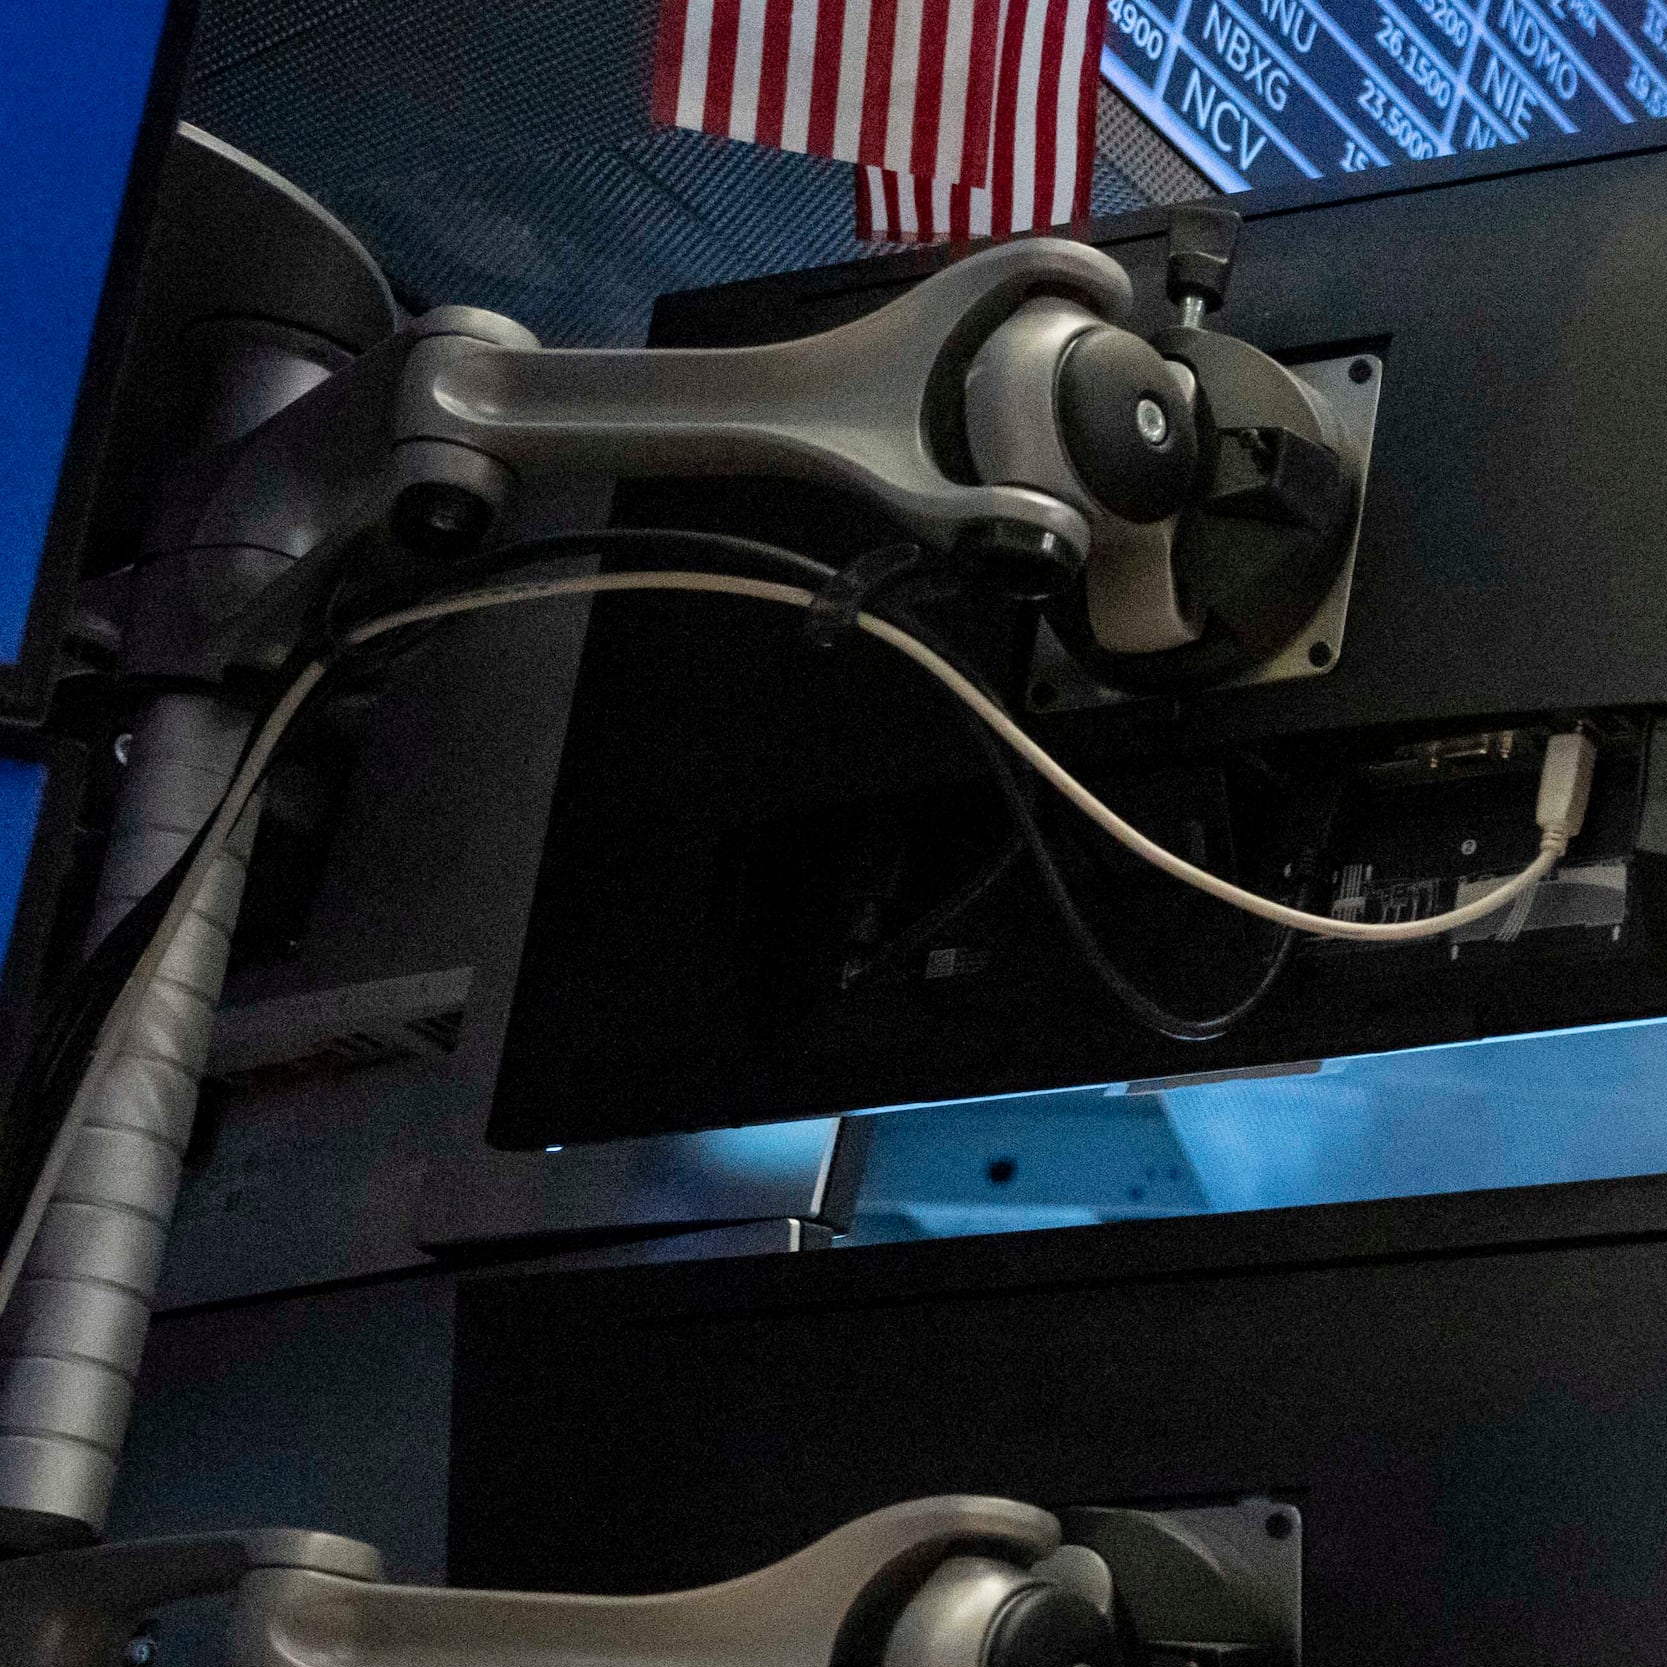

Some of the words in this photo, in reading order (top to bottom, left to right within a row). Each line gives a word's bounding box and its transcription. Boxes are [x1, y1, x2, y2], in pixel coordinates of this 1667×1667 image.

[1202, 2, 1290, 111] NBXG
[1481, 54, 1539, 140] NIE
[1181, 67, 1268, 171] NCV
